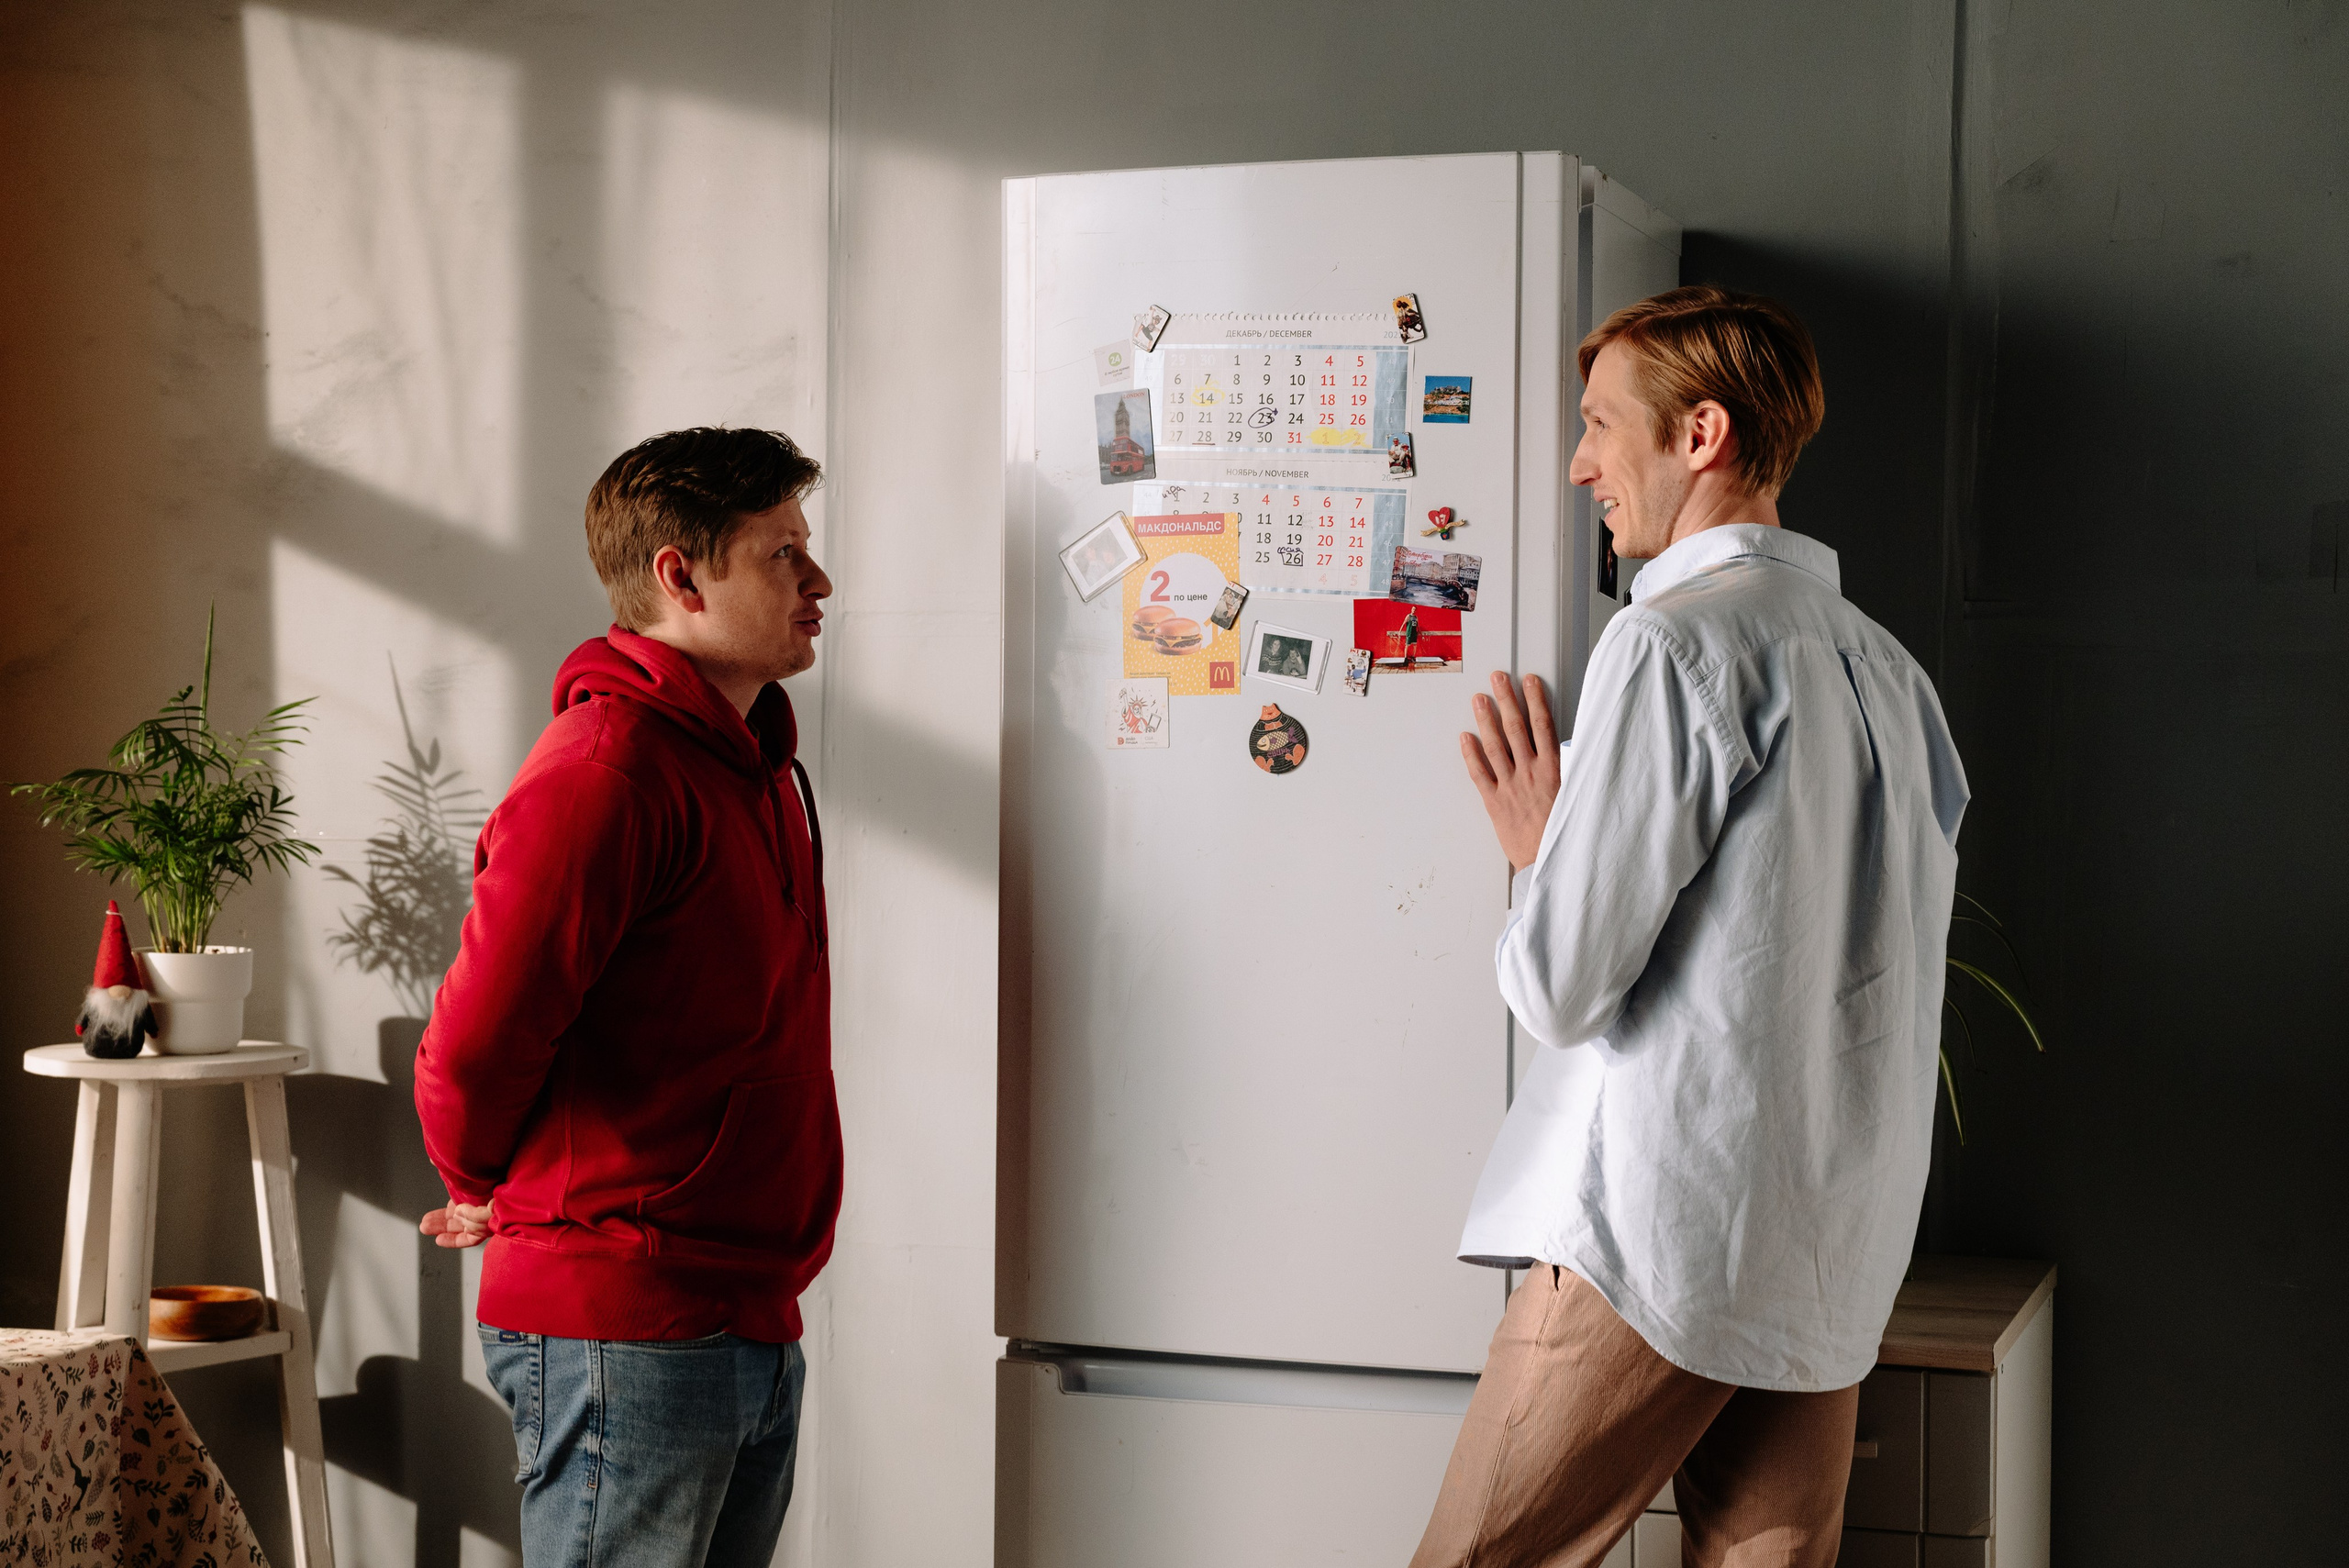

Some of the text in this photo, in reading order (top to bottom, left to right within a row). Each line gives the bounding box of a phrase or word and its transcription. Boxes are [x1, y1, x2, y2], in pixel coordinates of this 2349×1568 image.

[1234, 355, 1241, 365] 1
[1264, 355, 1271, 366] 2
[1295, 356, 1301, 366] 3
[1325, 356, 1333, 366] 4
[1357, 356, 1364, 367] 5
[1174, 374, 1182, 384] 6
[1205, 374, 1211, 384] 7
[1233, 374, 1241, 384] 8
[1264, 374, 1270, 385] 9
[1290, 375, 1305, 385] 10
[1321, 375, 1335, 385] 11
[1352, 375, 1367, 386] 12
[1171, 393, 1184, 403] 13
[1200, 394, 1214, 404] 14
[1229, 394, 1242, 404] 15
[1259, 394, 1274, 404] 16
[1290, 395, 1305, 405] 17
[1320, 395, 1335, 405] 18
[1352, 395, 1366, 406] 19
[1170, 412, 1184, 422] 20
[1198, 413, 1212, 423] 21
[1228, 413, 1241, 423] 22
[1258, 413, 1274, 424] 23
[1288, 414, 1304, 424] 24
[1319, 414, 1334, 424] 25
[1351, 415, 1365, 425] 26
[1169, 431, 1182, 441] 27
[1198, 431, 1211, 441] 28
[1227, 432, 1241, 442] 29
[1257, 432, 1272, 442] 30
[1287, 432, 1301, 443] 31
[1265, 470, 1308, 478] NOVEMBER
[1174, 492, 1179, 502] 1
[1204, 493, 1209, 503] 2
[1232, 494, 1239, 504] 3
[1262, 495, 1270, 505] 4
[1293, 495, 1299, 506] 5
[1323, 497, 1330, 507] 6
[1355, 498, 1363, 508] 7
[1138, 521, 1222, 534] МАКДОНАЛЬДС
[1257, 514, 1271, 524] 11
[1288, 515, 1303, 526] 12
[1319, 516, 1333, 527] 13
[1350, 517, 1365, 528] 14
[1257, 533, 1271, 543] 18
[1287, 534, 1302, 544] 19
[1318, 535, 1332, 546] 20
[1349, 537, 1364, 548] 21
[1255, 551, 1270, 562] 25
[1286, 553, 1300, 564] 26
[1317, 554, 1332, 565] 27
[1348, 556, 1363, 567] 28
[1319, 573, 1327, 584] 4
[1351, 574, 1357, 585] 5
[1151, 571, 1170, 602] 2
